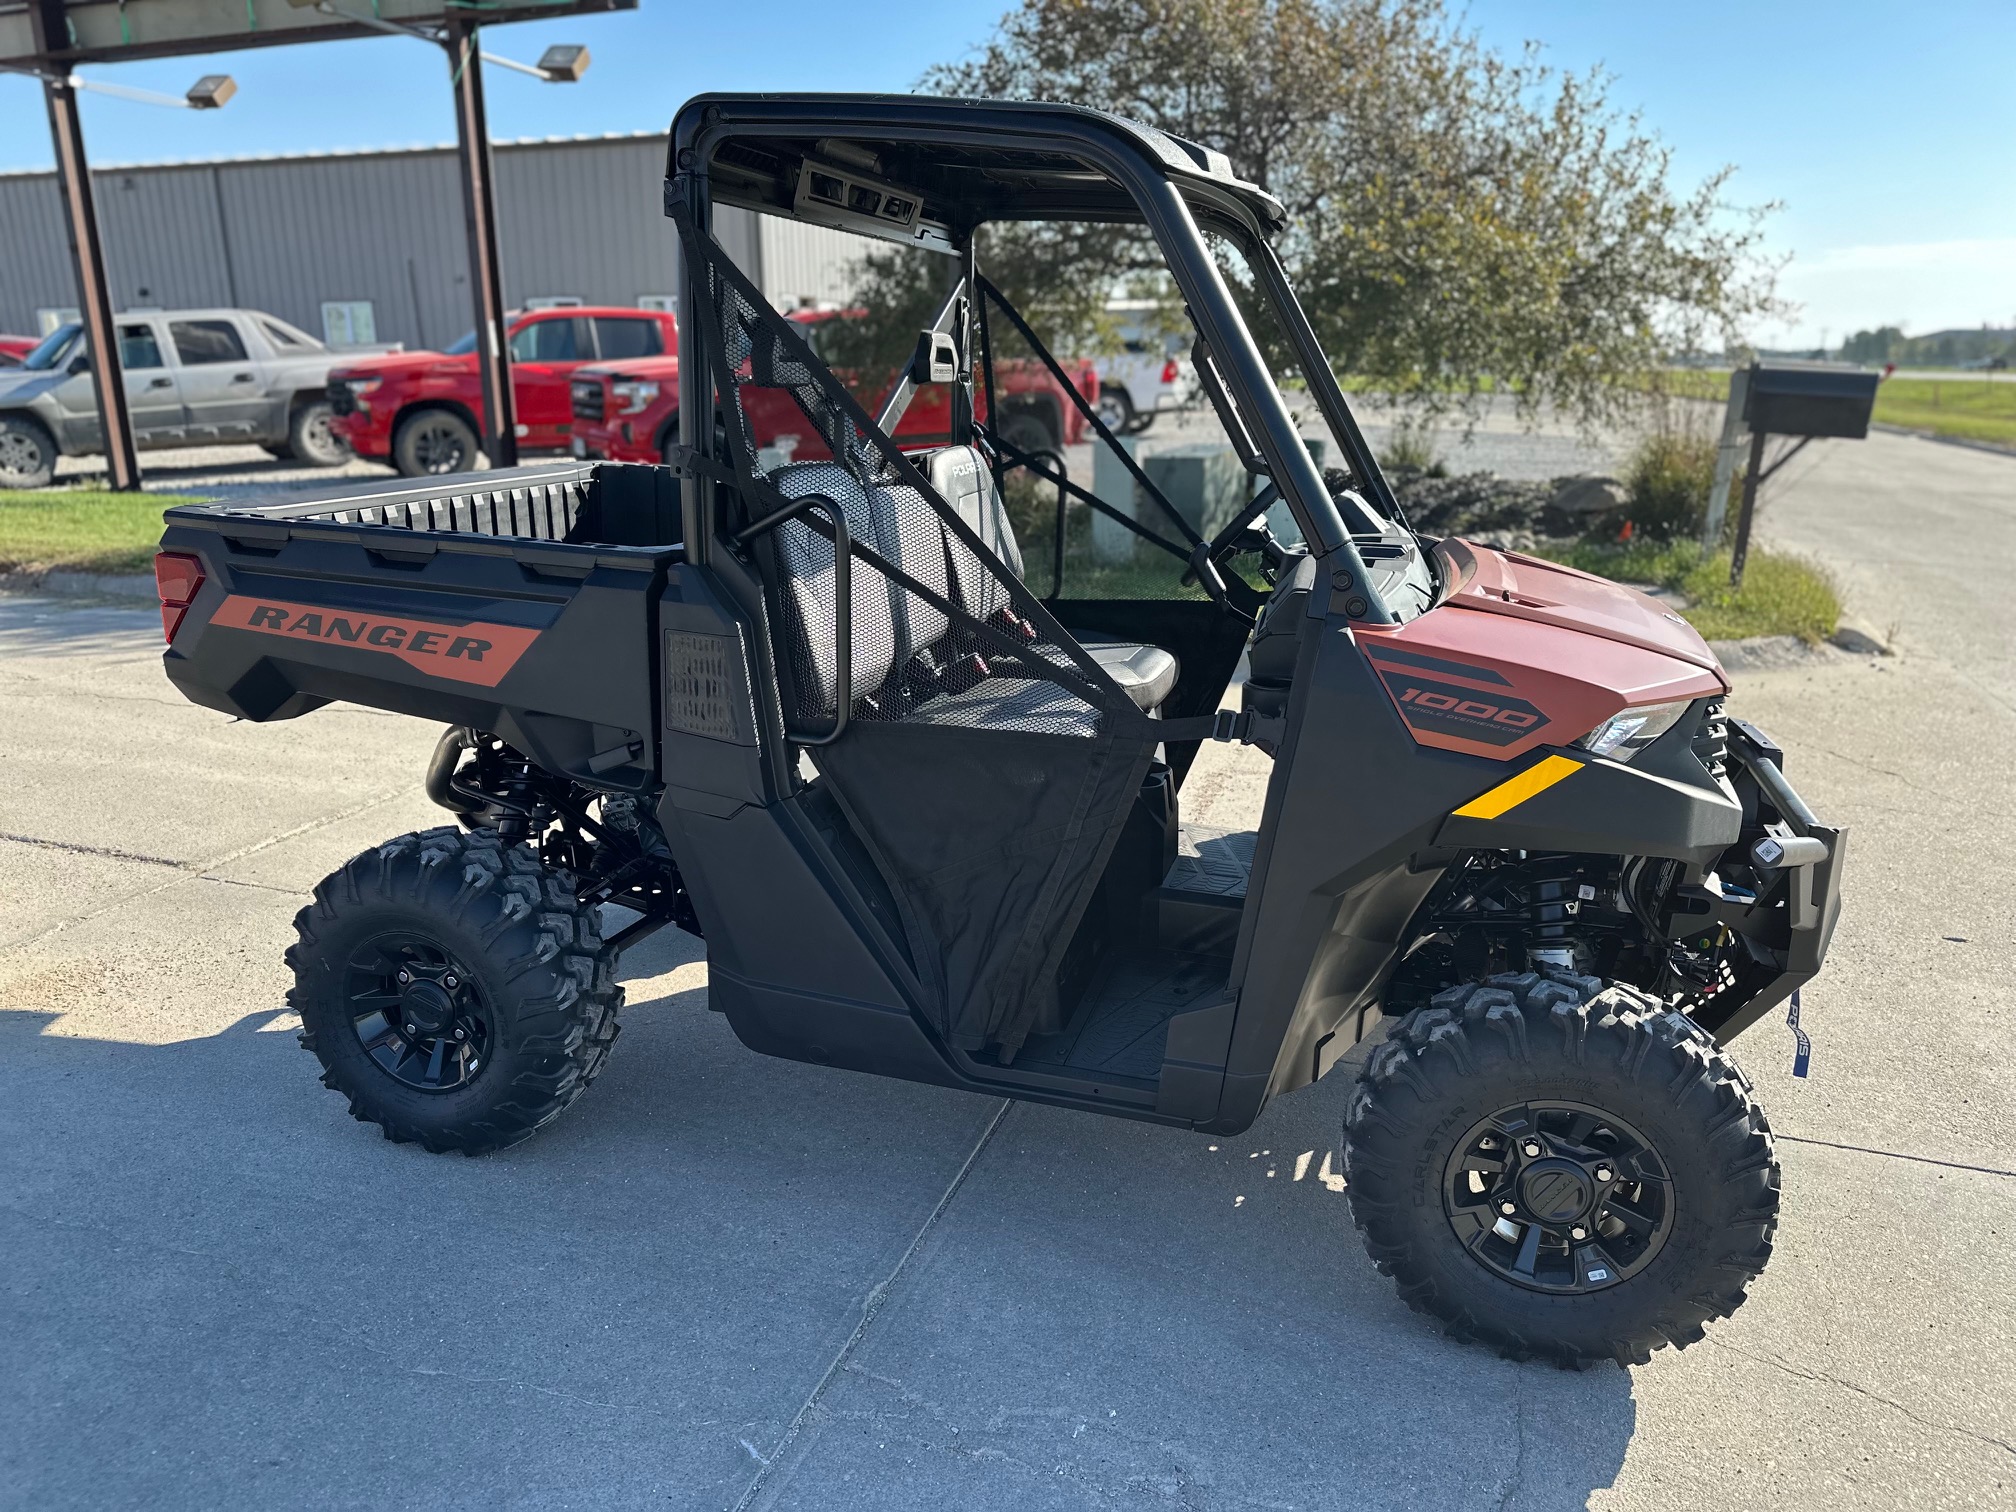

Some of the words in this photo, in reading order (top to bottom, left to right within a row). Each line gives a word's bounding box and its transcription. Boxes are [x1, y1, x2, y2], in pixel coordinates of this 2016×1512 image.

[952, 461, 981, 478] POLARS
[248, 606, 493, 662] RANGER
[1400, 687, 1539, 728] 1000
[1406, 705, 1443, 717] SINGLE
[1446, 714, 1501, 730] OVERHEAD
[1501, 726, 1525, 735] CAM
